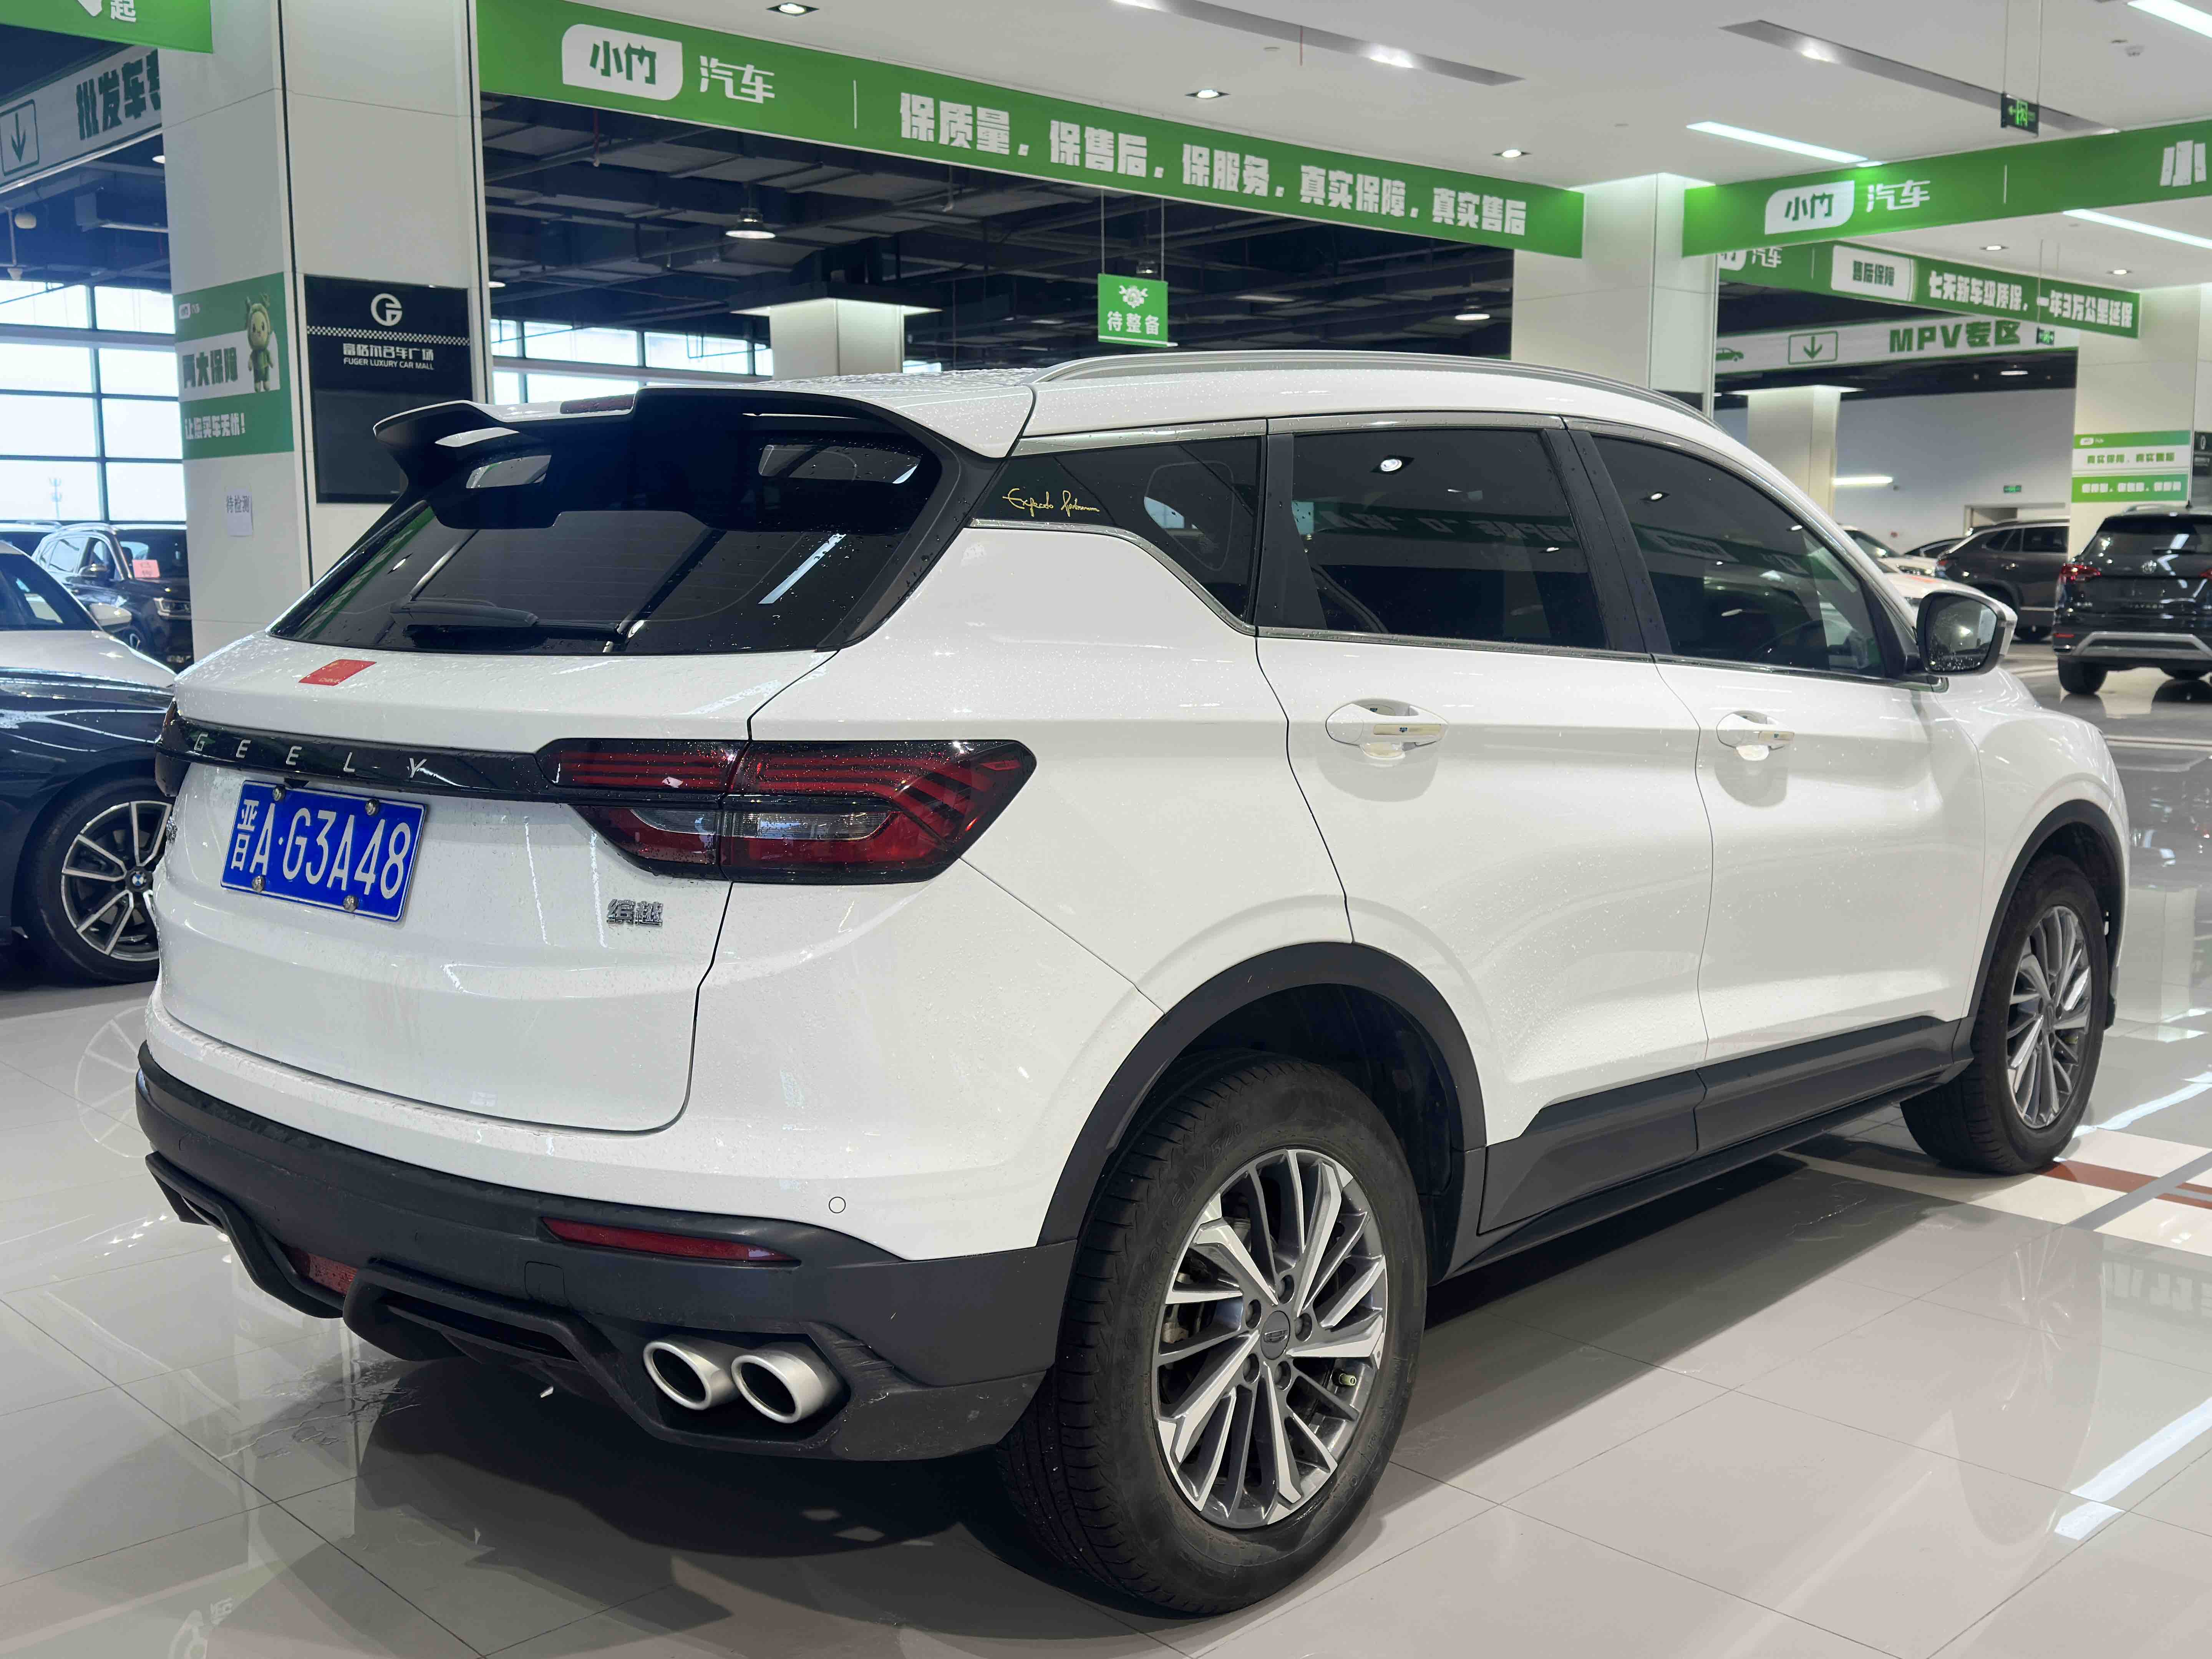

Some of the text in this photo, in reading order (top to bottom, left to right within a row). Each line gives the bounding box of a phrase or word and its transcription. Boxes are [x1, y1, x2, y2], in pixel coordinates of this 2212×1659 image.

[589, 40, 775, 104] 小竹 汽车
[1784, 180, 1930, 221] 小竹 汽车
[1106, 310, 1159, 335] 待整备
[343, 357, 368, 366] FUGER
[370, 359, 398, 368] LUXURY
[194, 733, 427, 778] GEELY
